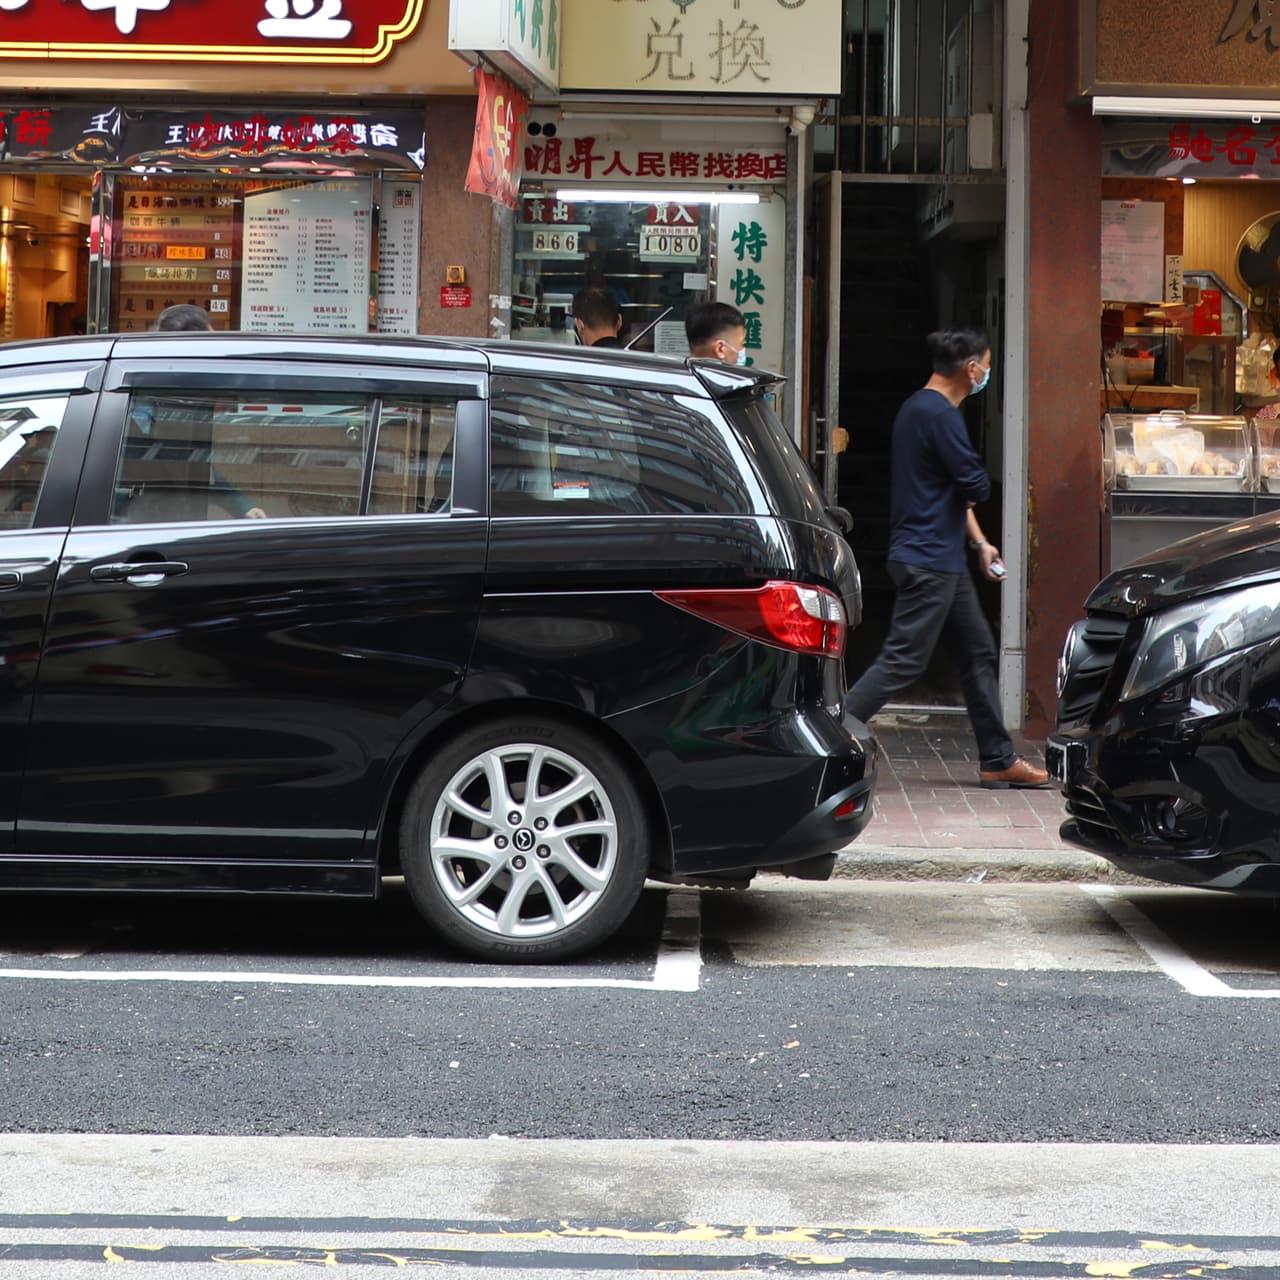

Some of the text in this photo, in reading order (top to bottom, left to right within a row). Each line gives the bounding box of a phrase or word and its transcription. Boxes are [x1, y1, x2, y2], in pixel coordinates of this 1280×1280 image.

[528, 200, 569, 222] 賣出
[653, 201, 694, 223] 買入
[536, 234, 575, 250] 866
[643, 236, 699, 253] 1080
[730, 220, 768, 368] 特快匯
